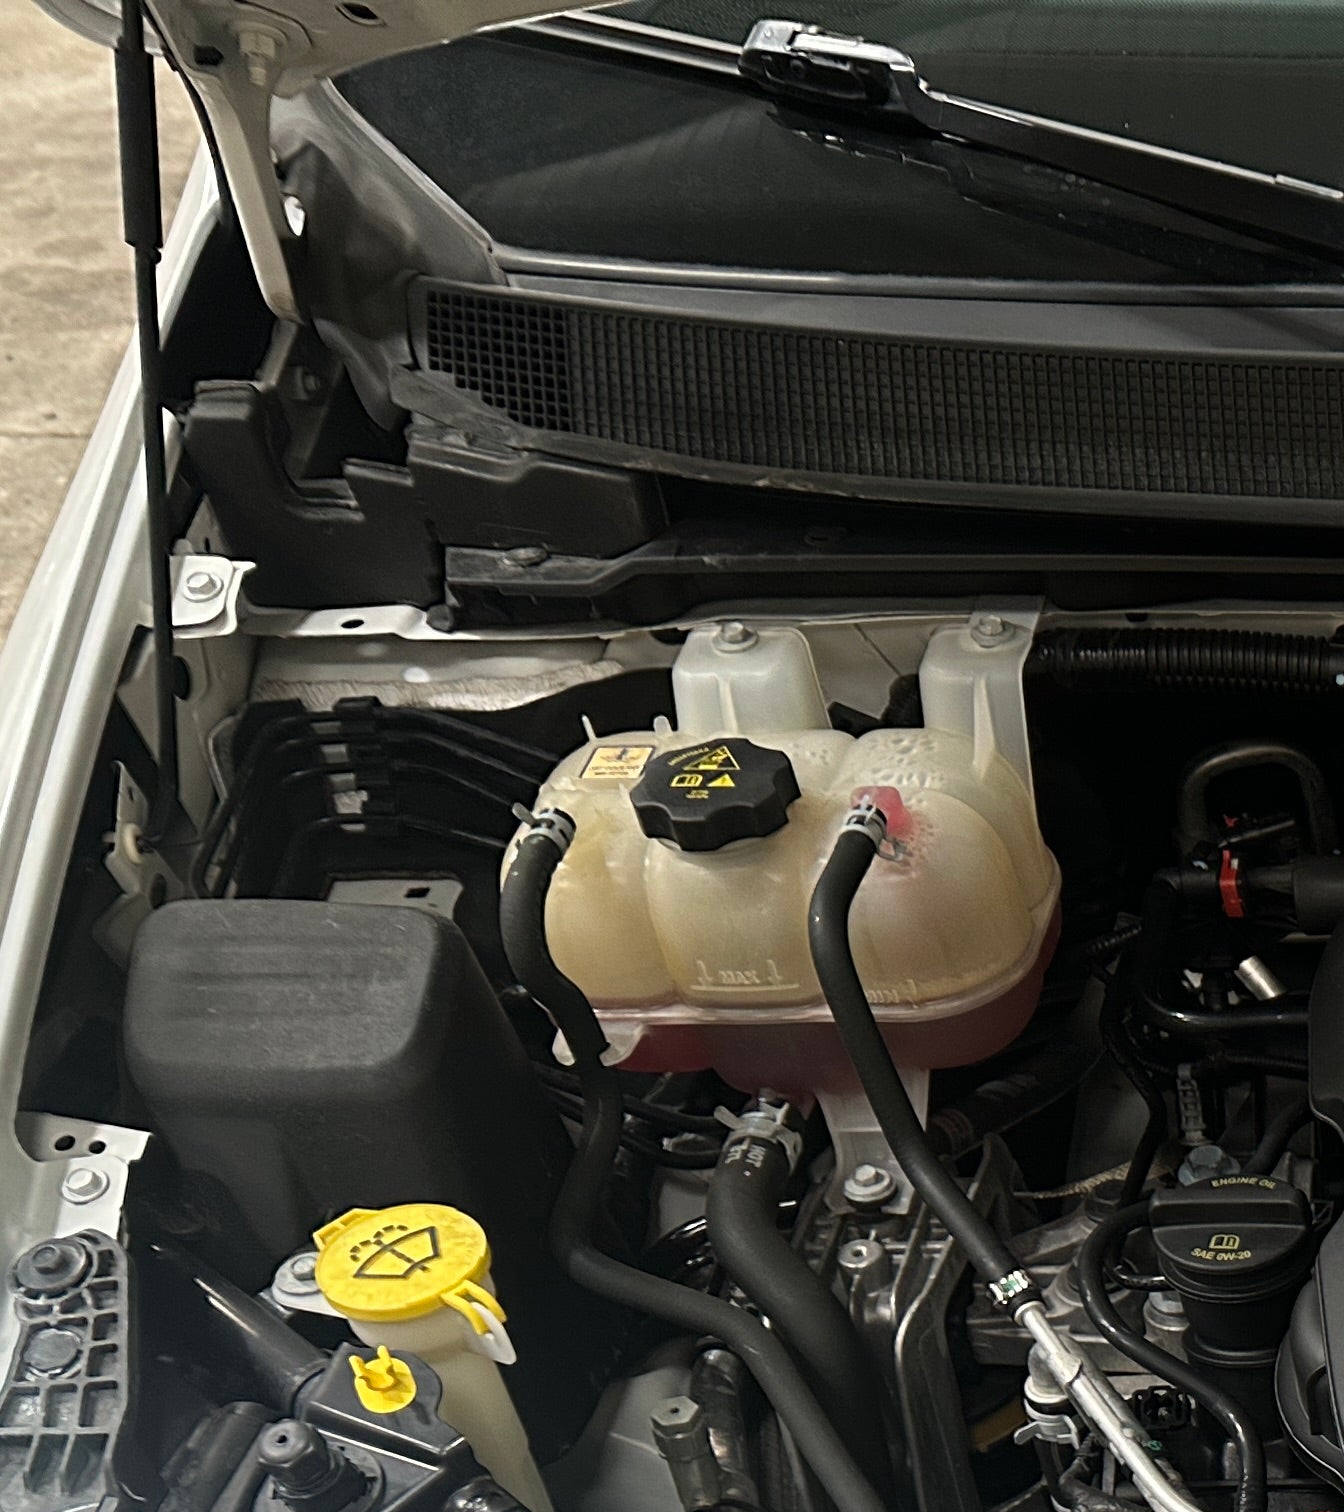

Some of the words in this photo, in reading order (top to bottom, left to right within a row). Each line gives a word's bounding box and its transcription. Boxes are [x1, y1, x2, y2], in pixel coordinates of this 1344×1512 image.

[1211, 1177, 1258, 1188] ENGINE
[1258, 1179, 1277, 1190] OIL
[1190, 1248, 1216, 1260] SAE
[1216, 1250, 1252, 1261] 0W-20
